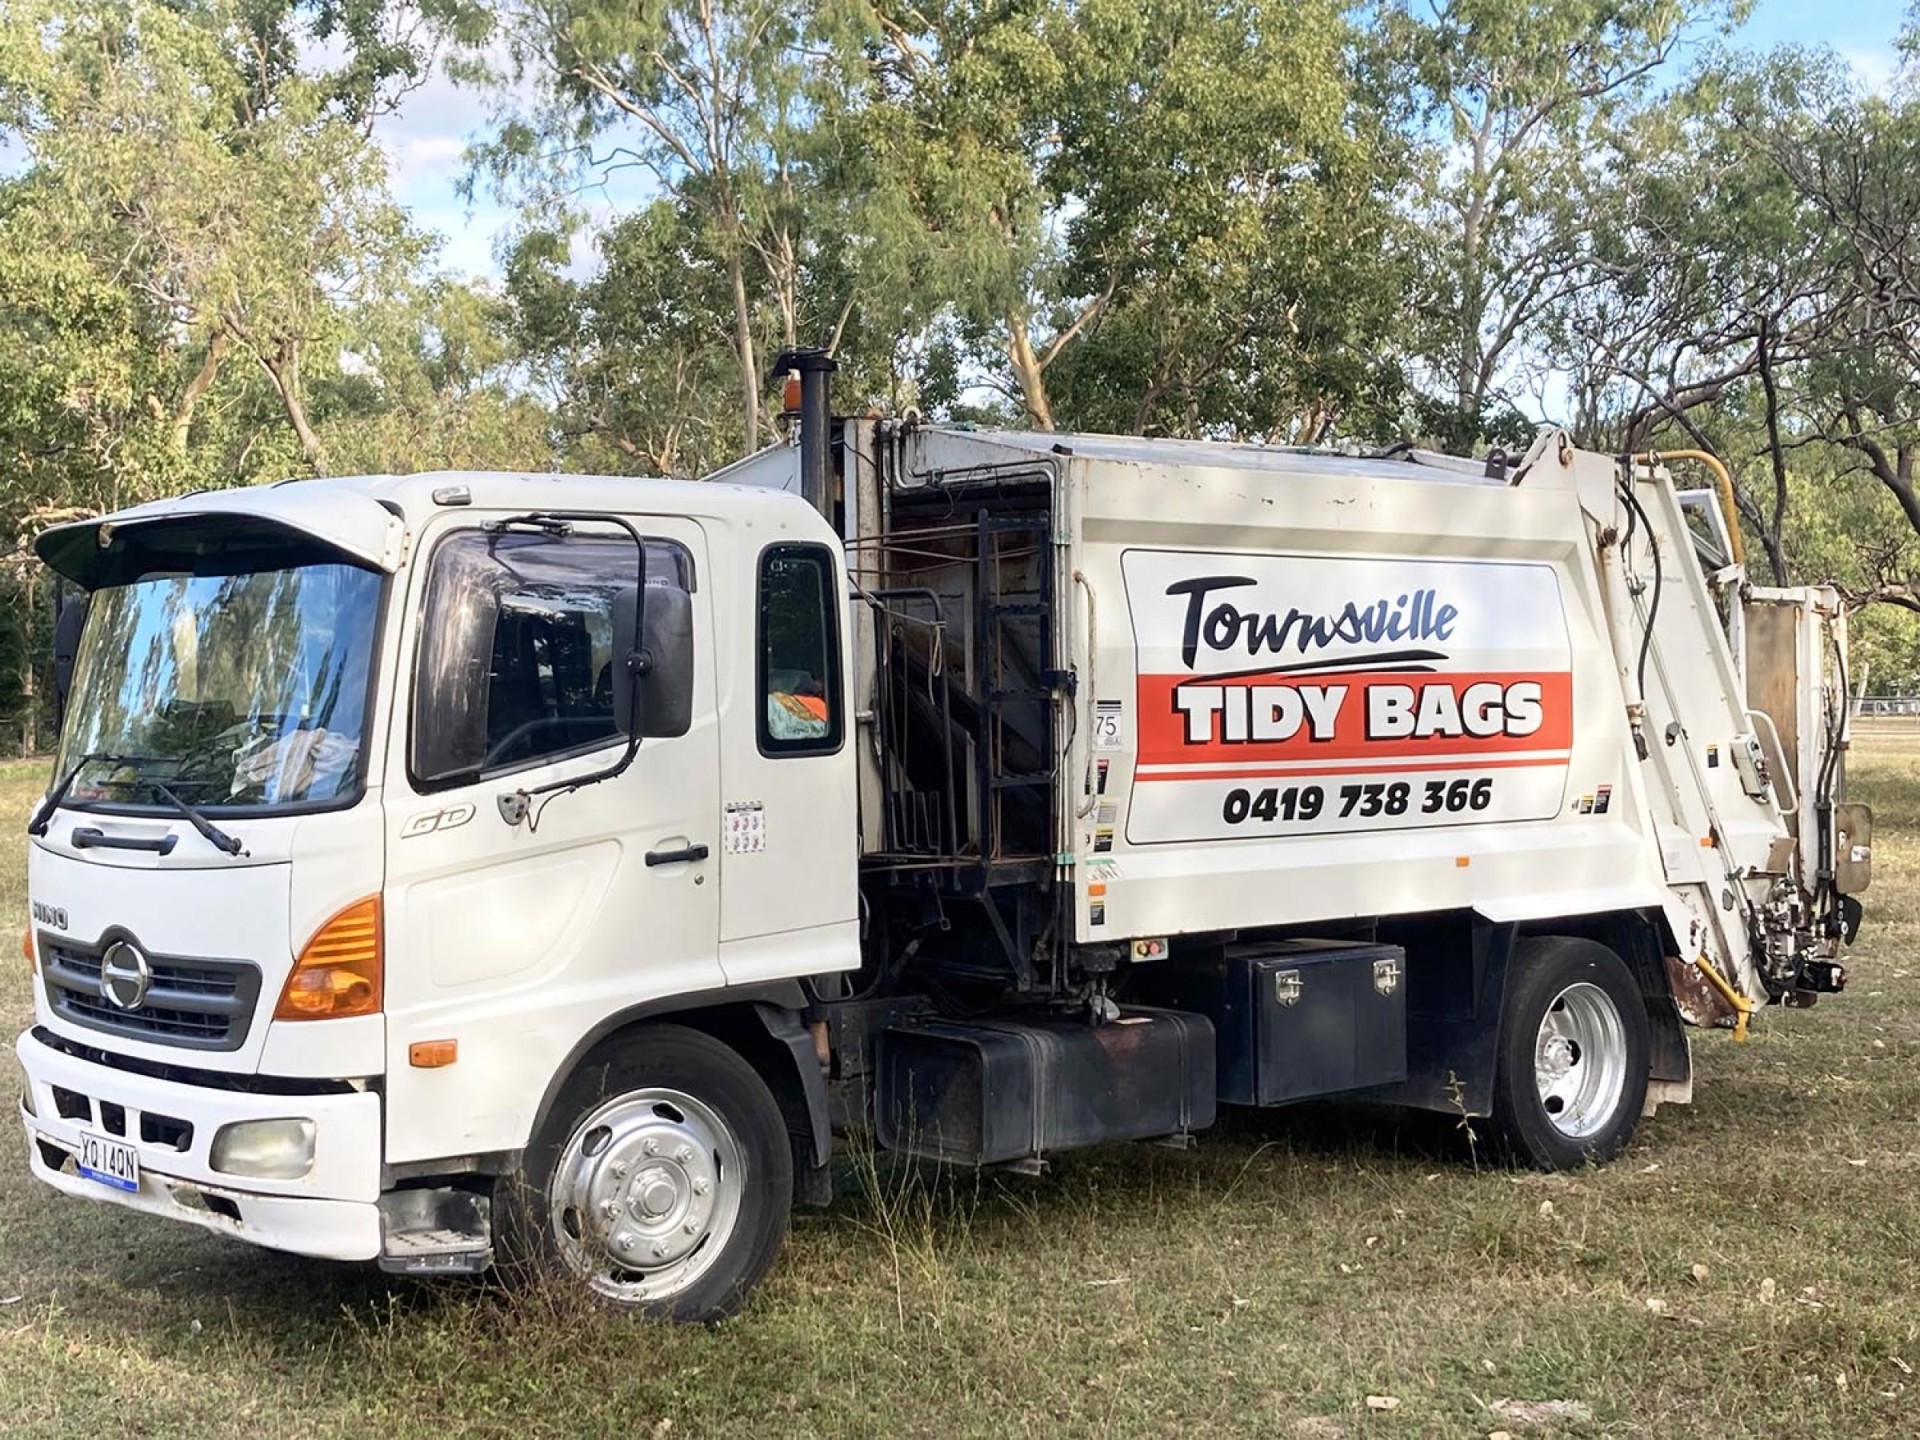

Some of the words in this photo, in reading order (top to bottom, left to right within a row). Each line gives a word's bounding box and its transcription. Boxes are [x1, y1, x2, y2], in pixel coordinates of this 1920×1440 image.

[1165, 576, 1458, 670] Townsville
[1096, 716, 1117, 736] 75
[1173, 683, 1349, 745] TIDY
[1365, 681, 1543, 741] BAGS
[1222, 785, 1325, 825] 0419
[1339, 781, 1411, 818] 738
[1421, 778, 1494, 814] 366
[33, 900, 69, 931] HINO
[81, 1136, 98, 1168] XQ
